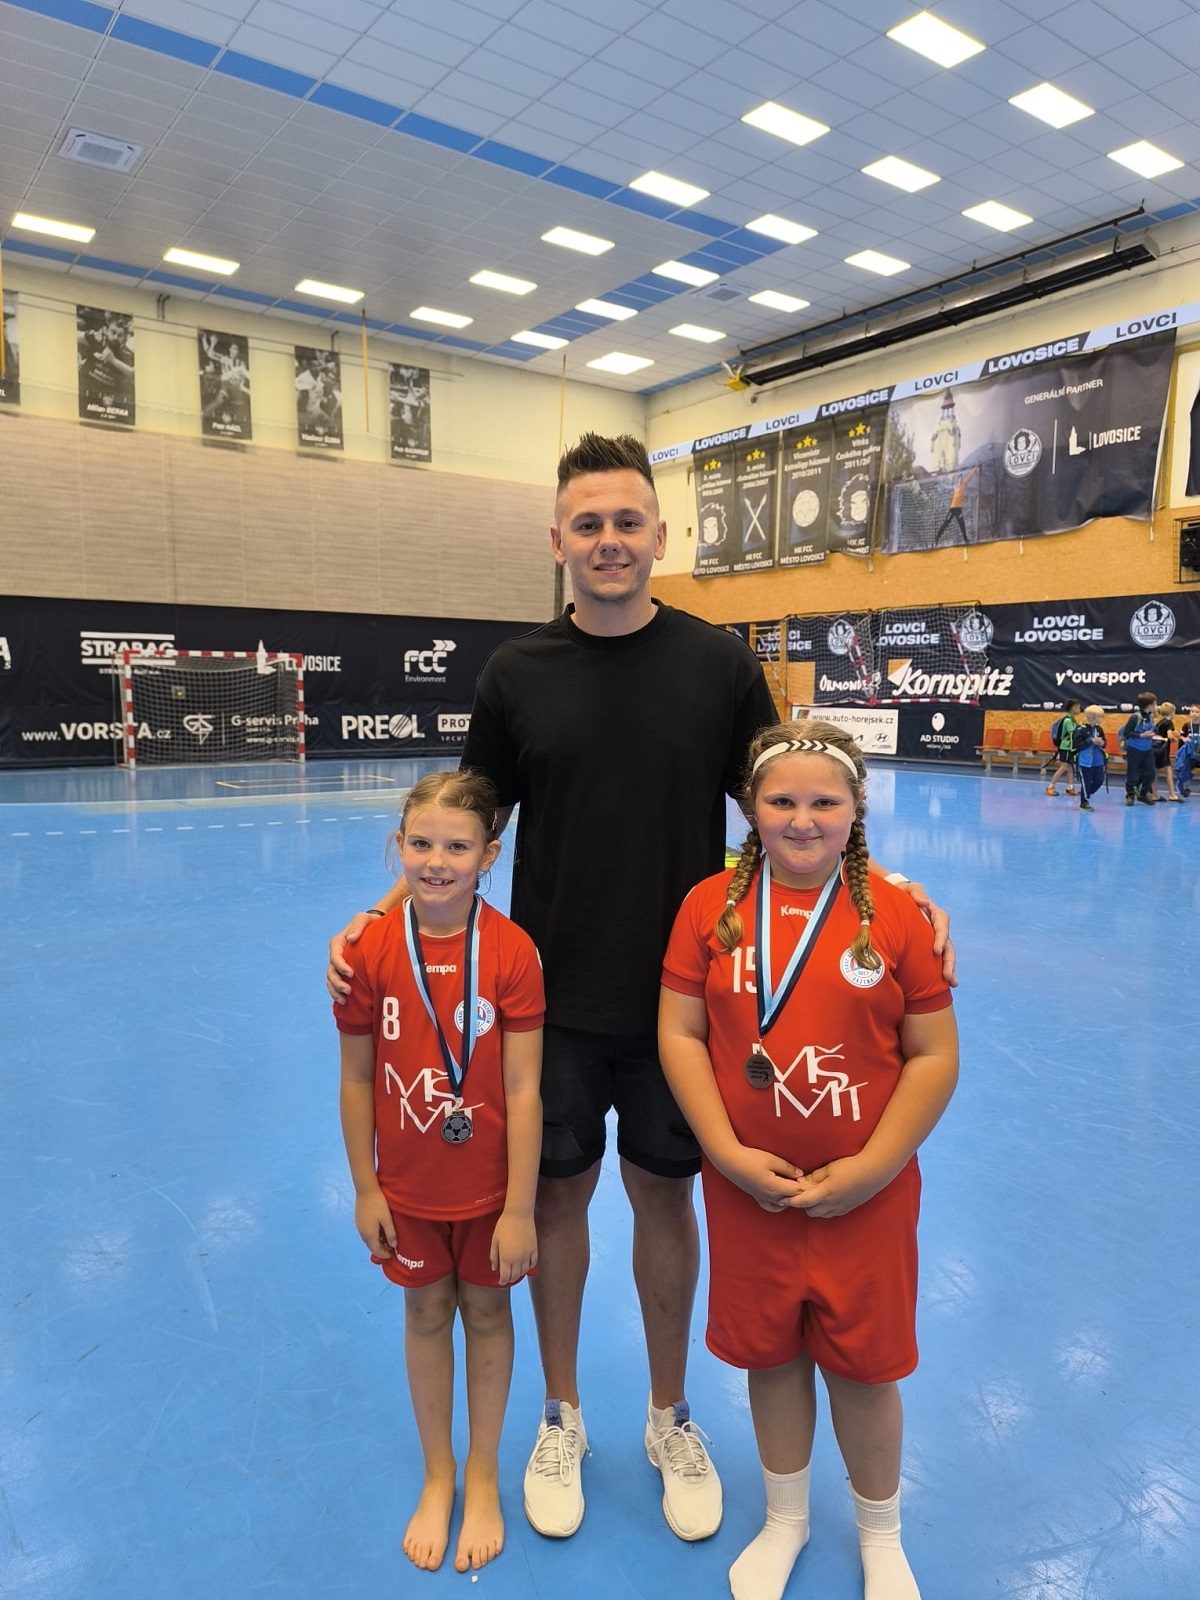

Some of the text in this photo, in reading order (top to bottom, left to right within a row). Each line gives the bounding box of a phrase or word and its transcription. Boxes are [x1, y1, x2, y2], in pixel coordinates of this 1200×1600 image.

[1116, 312, 1177, 338] LOVCI
[988, 338, 1080, 373] LOVOSICE
[914, 370, 958, 391] LOVCI
[1024, 378, 1104, 405] GENERÁLNÍ PARTNER
[821, 389, 889, 416] LOVOSICE
[765, 414, 800, 431] LOVCI
[695, 428, 747, 450] LOVOSICE
[1092, 426, 1142, 449] LOVOSICE
[652, 448, 679, 462] LOVCI
[885, 622, 926, 634] LOVCI
[1033, 615, 1085, 628] LOVCI
[768, 630, 800, 641] LOCI
[1014, 628, 1104, 642] LOVOSICE
[1137, 626, 1168, 635] LOVCI
[757, 640, 812, 652] LOVSICE
[404, 650, 448, 673] FCC
[404, 674, 446, 683] Environment
[231, 714, 319, 726] G-servis Prha
[812, 714, 894, 725] www.auto-horejsek.cz
[22, 722, 171, 741] www.VORSA.cz
[920, 734, 960, 744] AD STUDIO
[780, 904, 814, 920] Kemp
[424, 962, 456, 976] empa
[382, 996, 400, 1040] 8
[396, 1252, 424, 1270] empa
